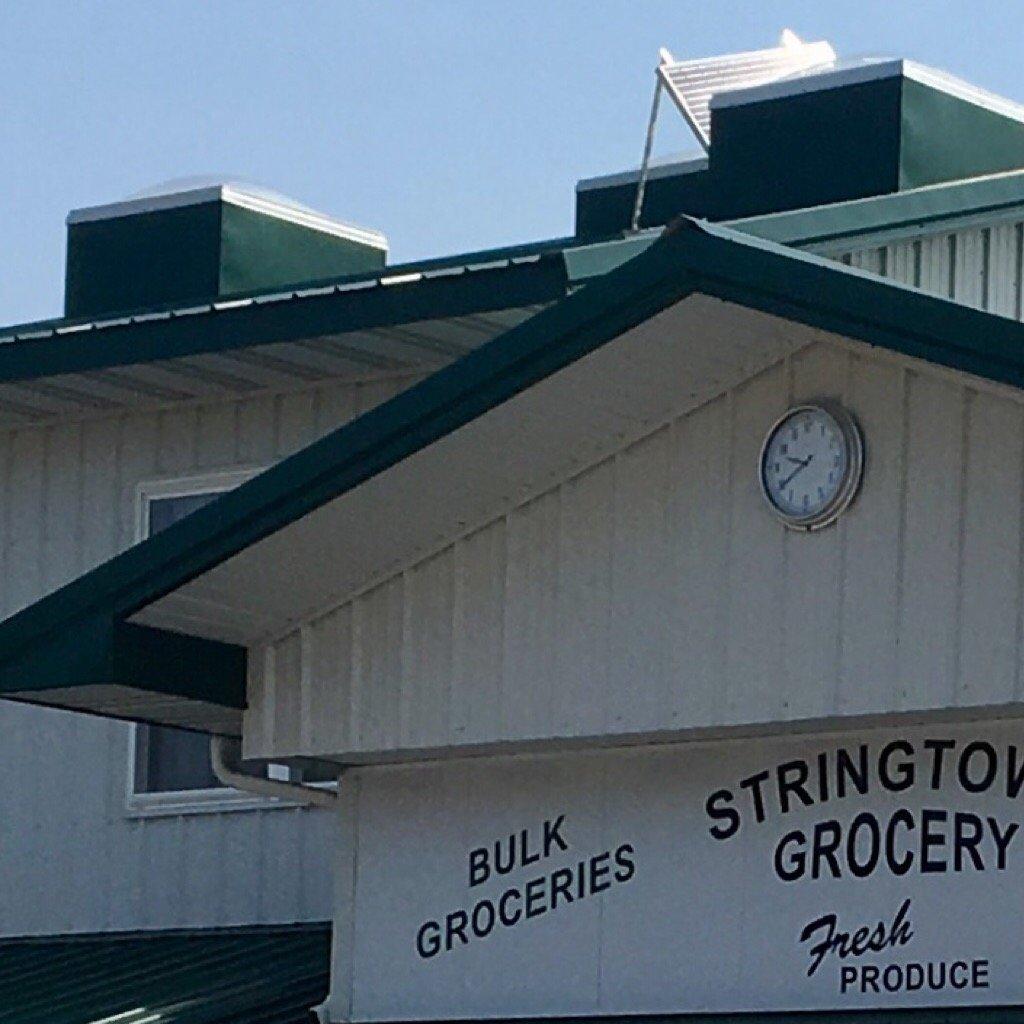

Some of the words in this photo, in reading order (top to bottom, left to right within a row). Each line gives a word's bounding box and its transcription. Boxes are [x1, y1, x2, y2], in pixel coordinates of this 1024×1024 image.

[468, 814, 568, 887] BULK
[774, 809, 1020, 881] GROCERY
[416, 844, 635, 959] GROCERIES
[800, 898, 913, 976] Fresh
[840, 959, 989, 994] PRODUCE
